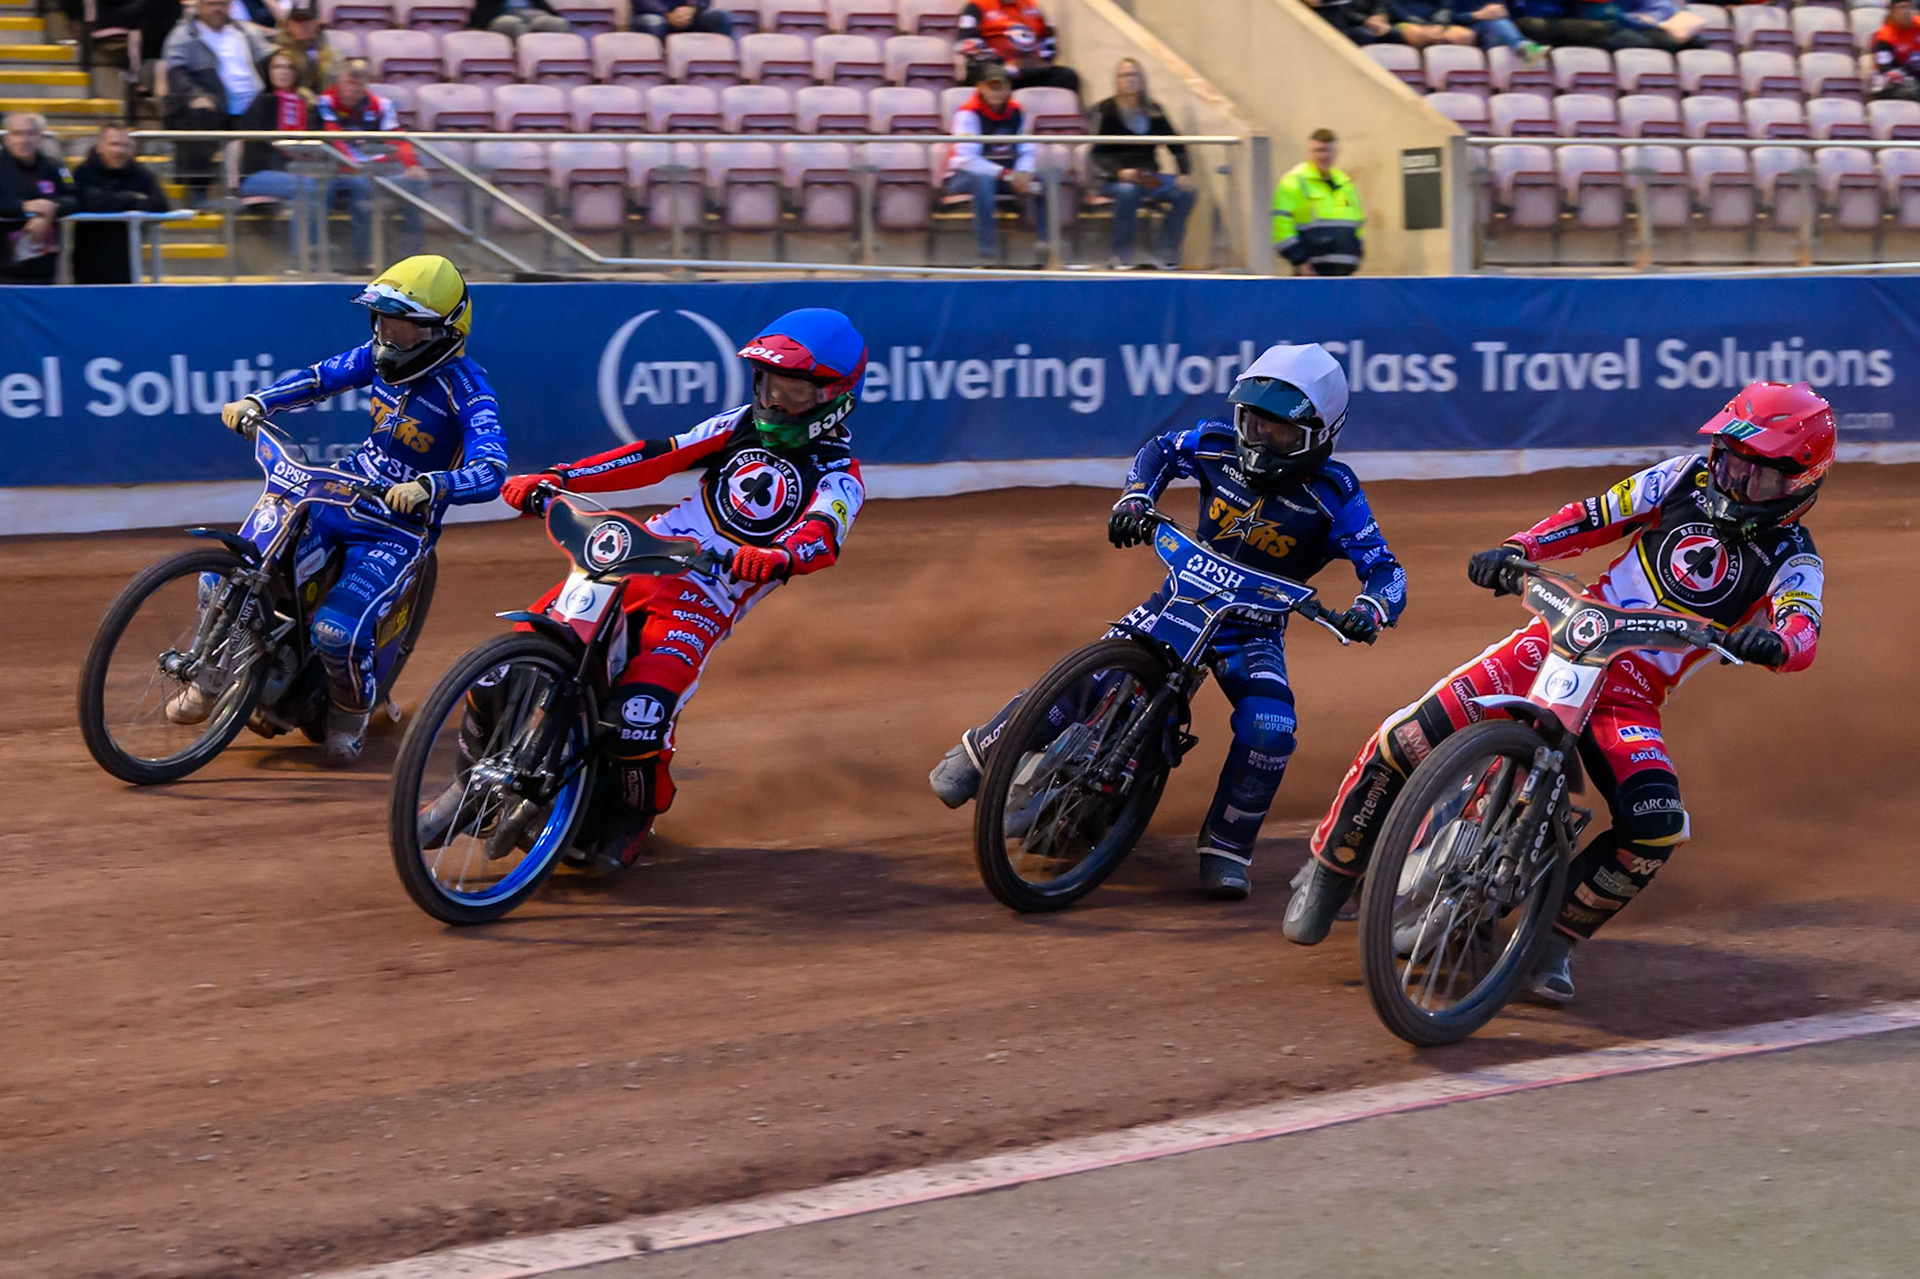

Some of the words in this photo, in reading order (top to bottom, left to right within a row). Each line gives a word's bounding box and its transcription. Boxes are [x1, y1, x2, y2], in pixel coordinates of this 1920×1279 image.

[738, 346, 784, 364] BOLL
[861, 344, 1107, 414] elivering
[1119, 339, 1256, 397] Worl
[1318, 338, 1460, 393] lass
[1472, 337, 1641, 392] Travel
[1656, 336, 1896, 390] Solutions
[623, 361, 718, 406] ATPI
[808, 399, 853, 440] BOLL
[735, 452, 769, 467] BELLE
[772, 459, 794, 477] VUE
[785, 477, 799, 508] ACES
[1221, 463, 1245, 482] ROW
[1202, 558, 1247, 590] PSH
[1680, 526, 1714, 537] BELLE
[1726, 554, 1740, 582] ACES
[621, 728, 658, 740] BOLL
